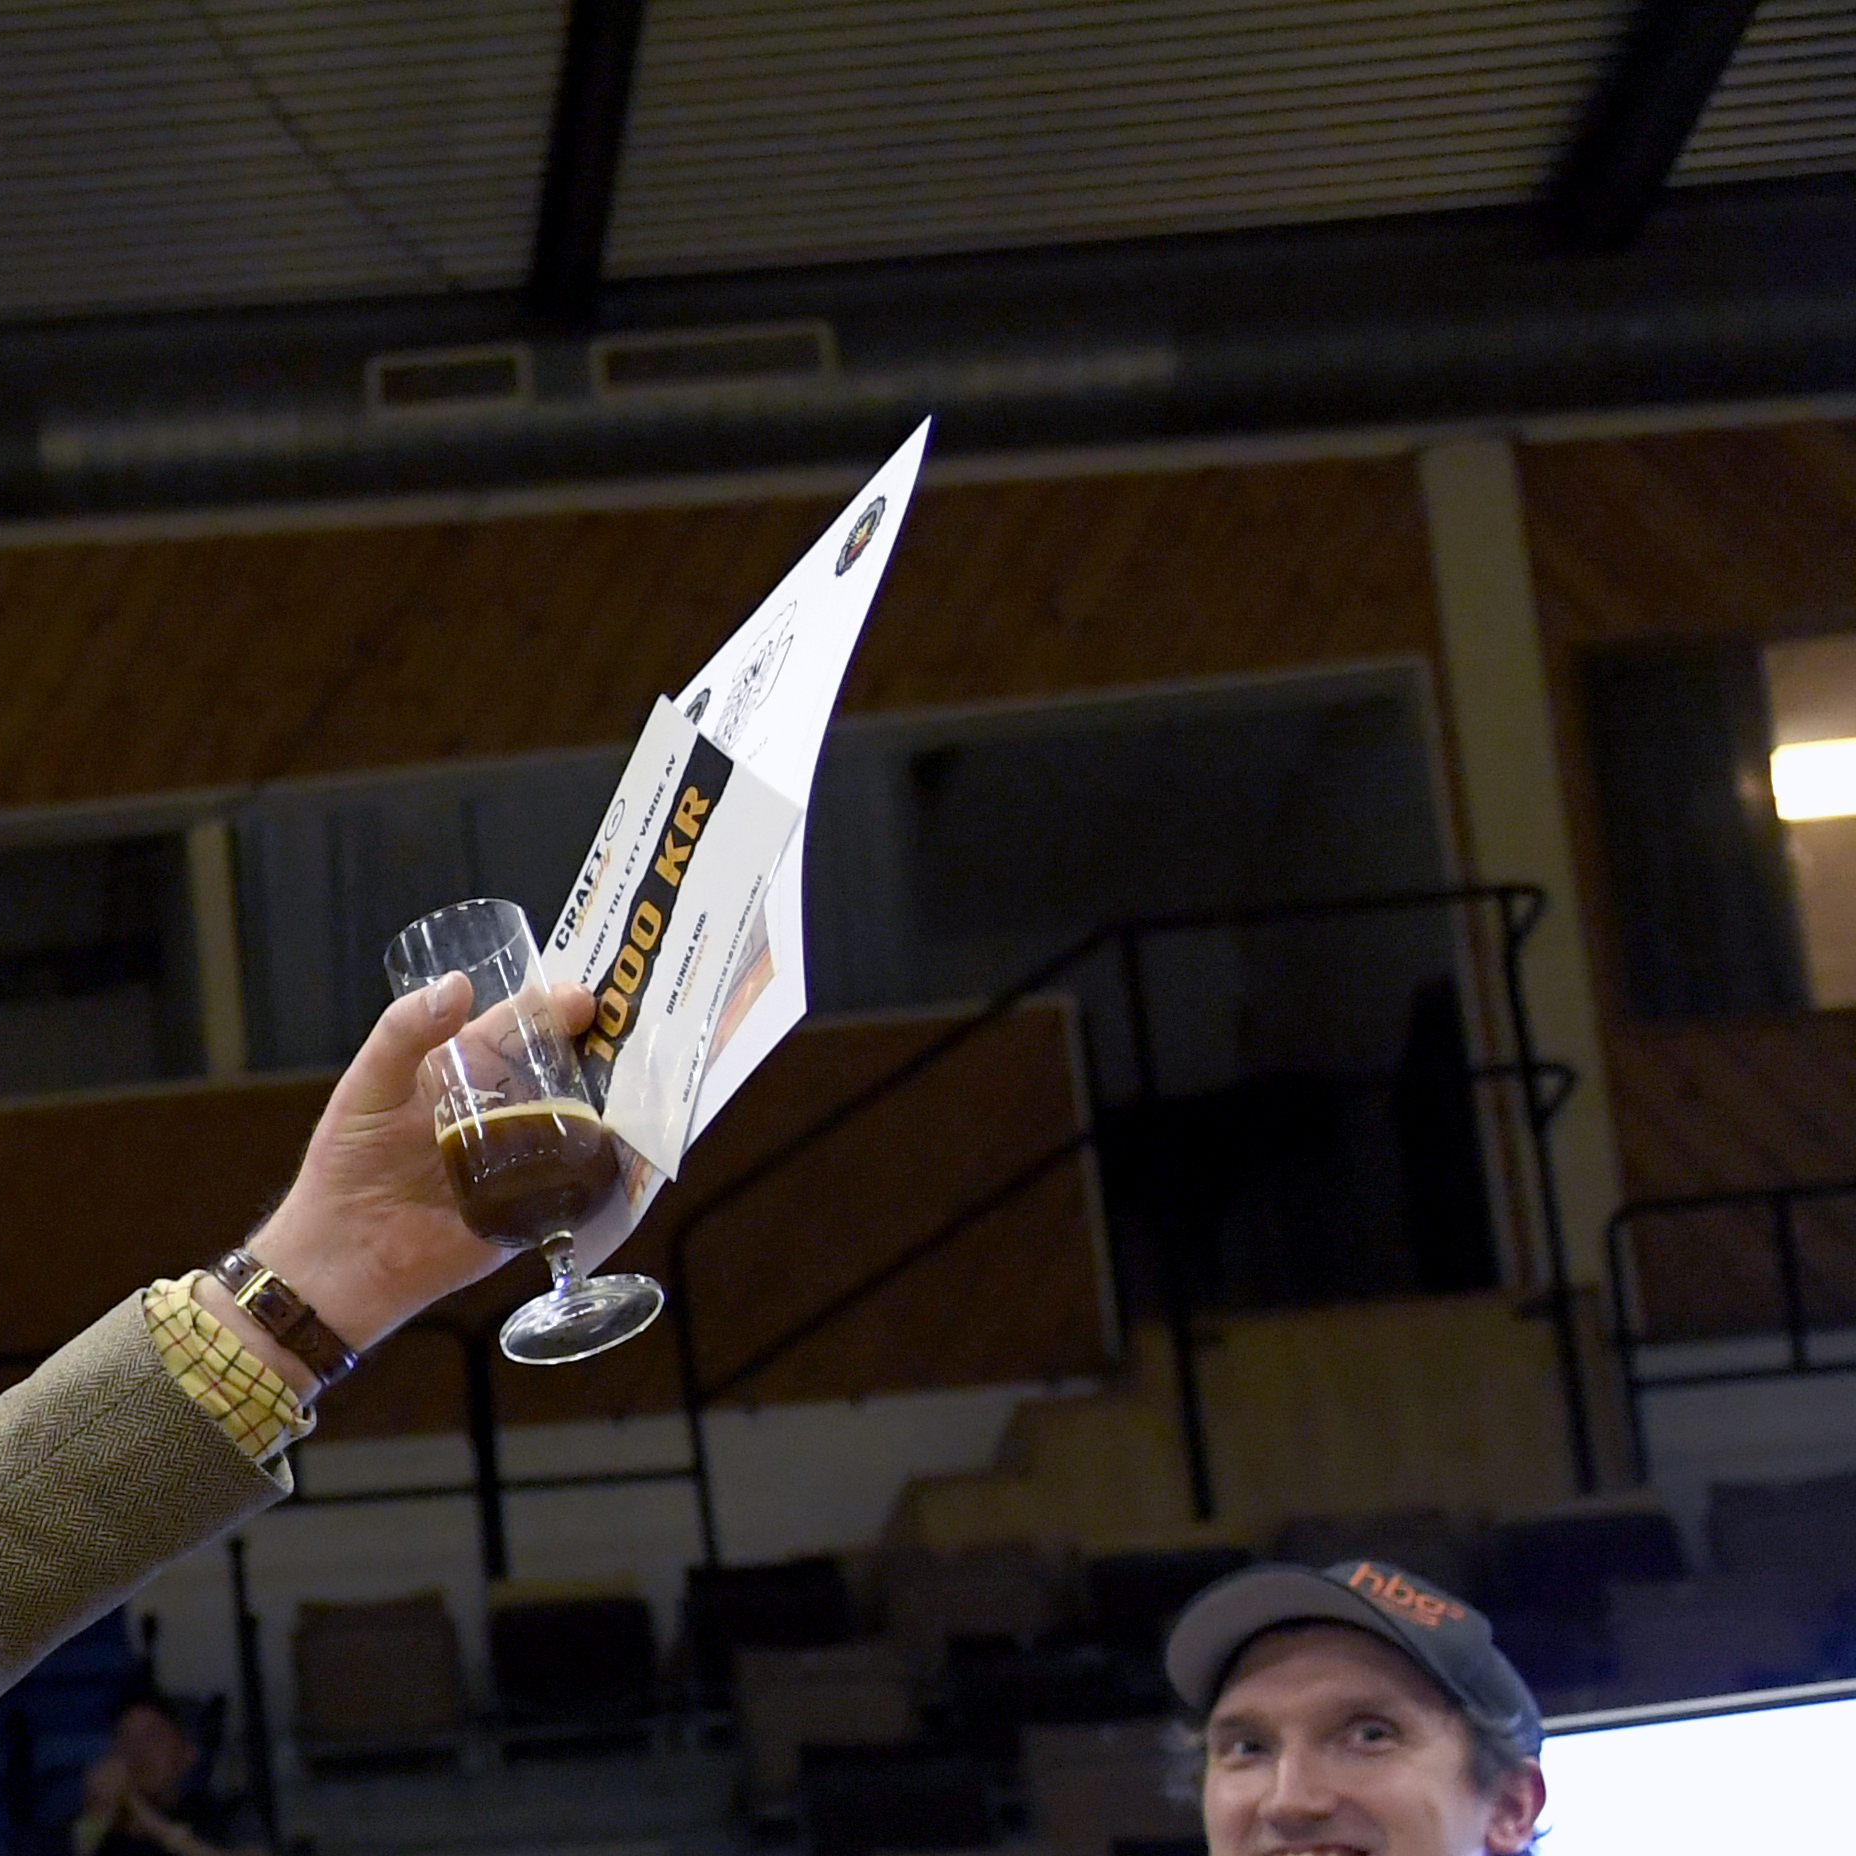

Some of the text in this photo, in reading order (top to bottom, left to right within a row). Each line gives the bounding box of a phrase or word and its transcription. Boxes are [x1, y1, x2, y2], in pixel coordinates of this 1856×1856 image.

[554, 842, 603, 952] CRAFT
[580, 753, 678, 985] NTKORT TILL ETT VÄRDE AV
[585, 785, 710, 1062] 1000 KR
[665, 910, 708, 1015] DIN UNIKA KOD:
